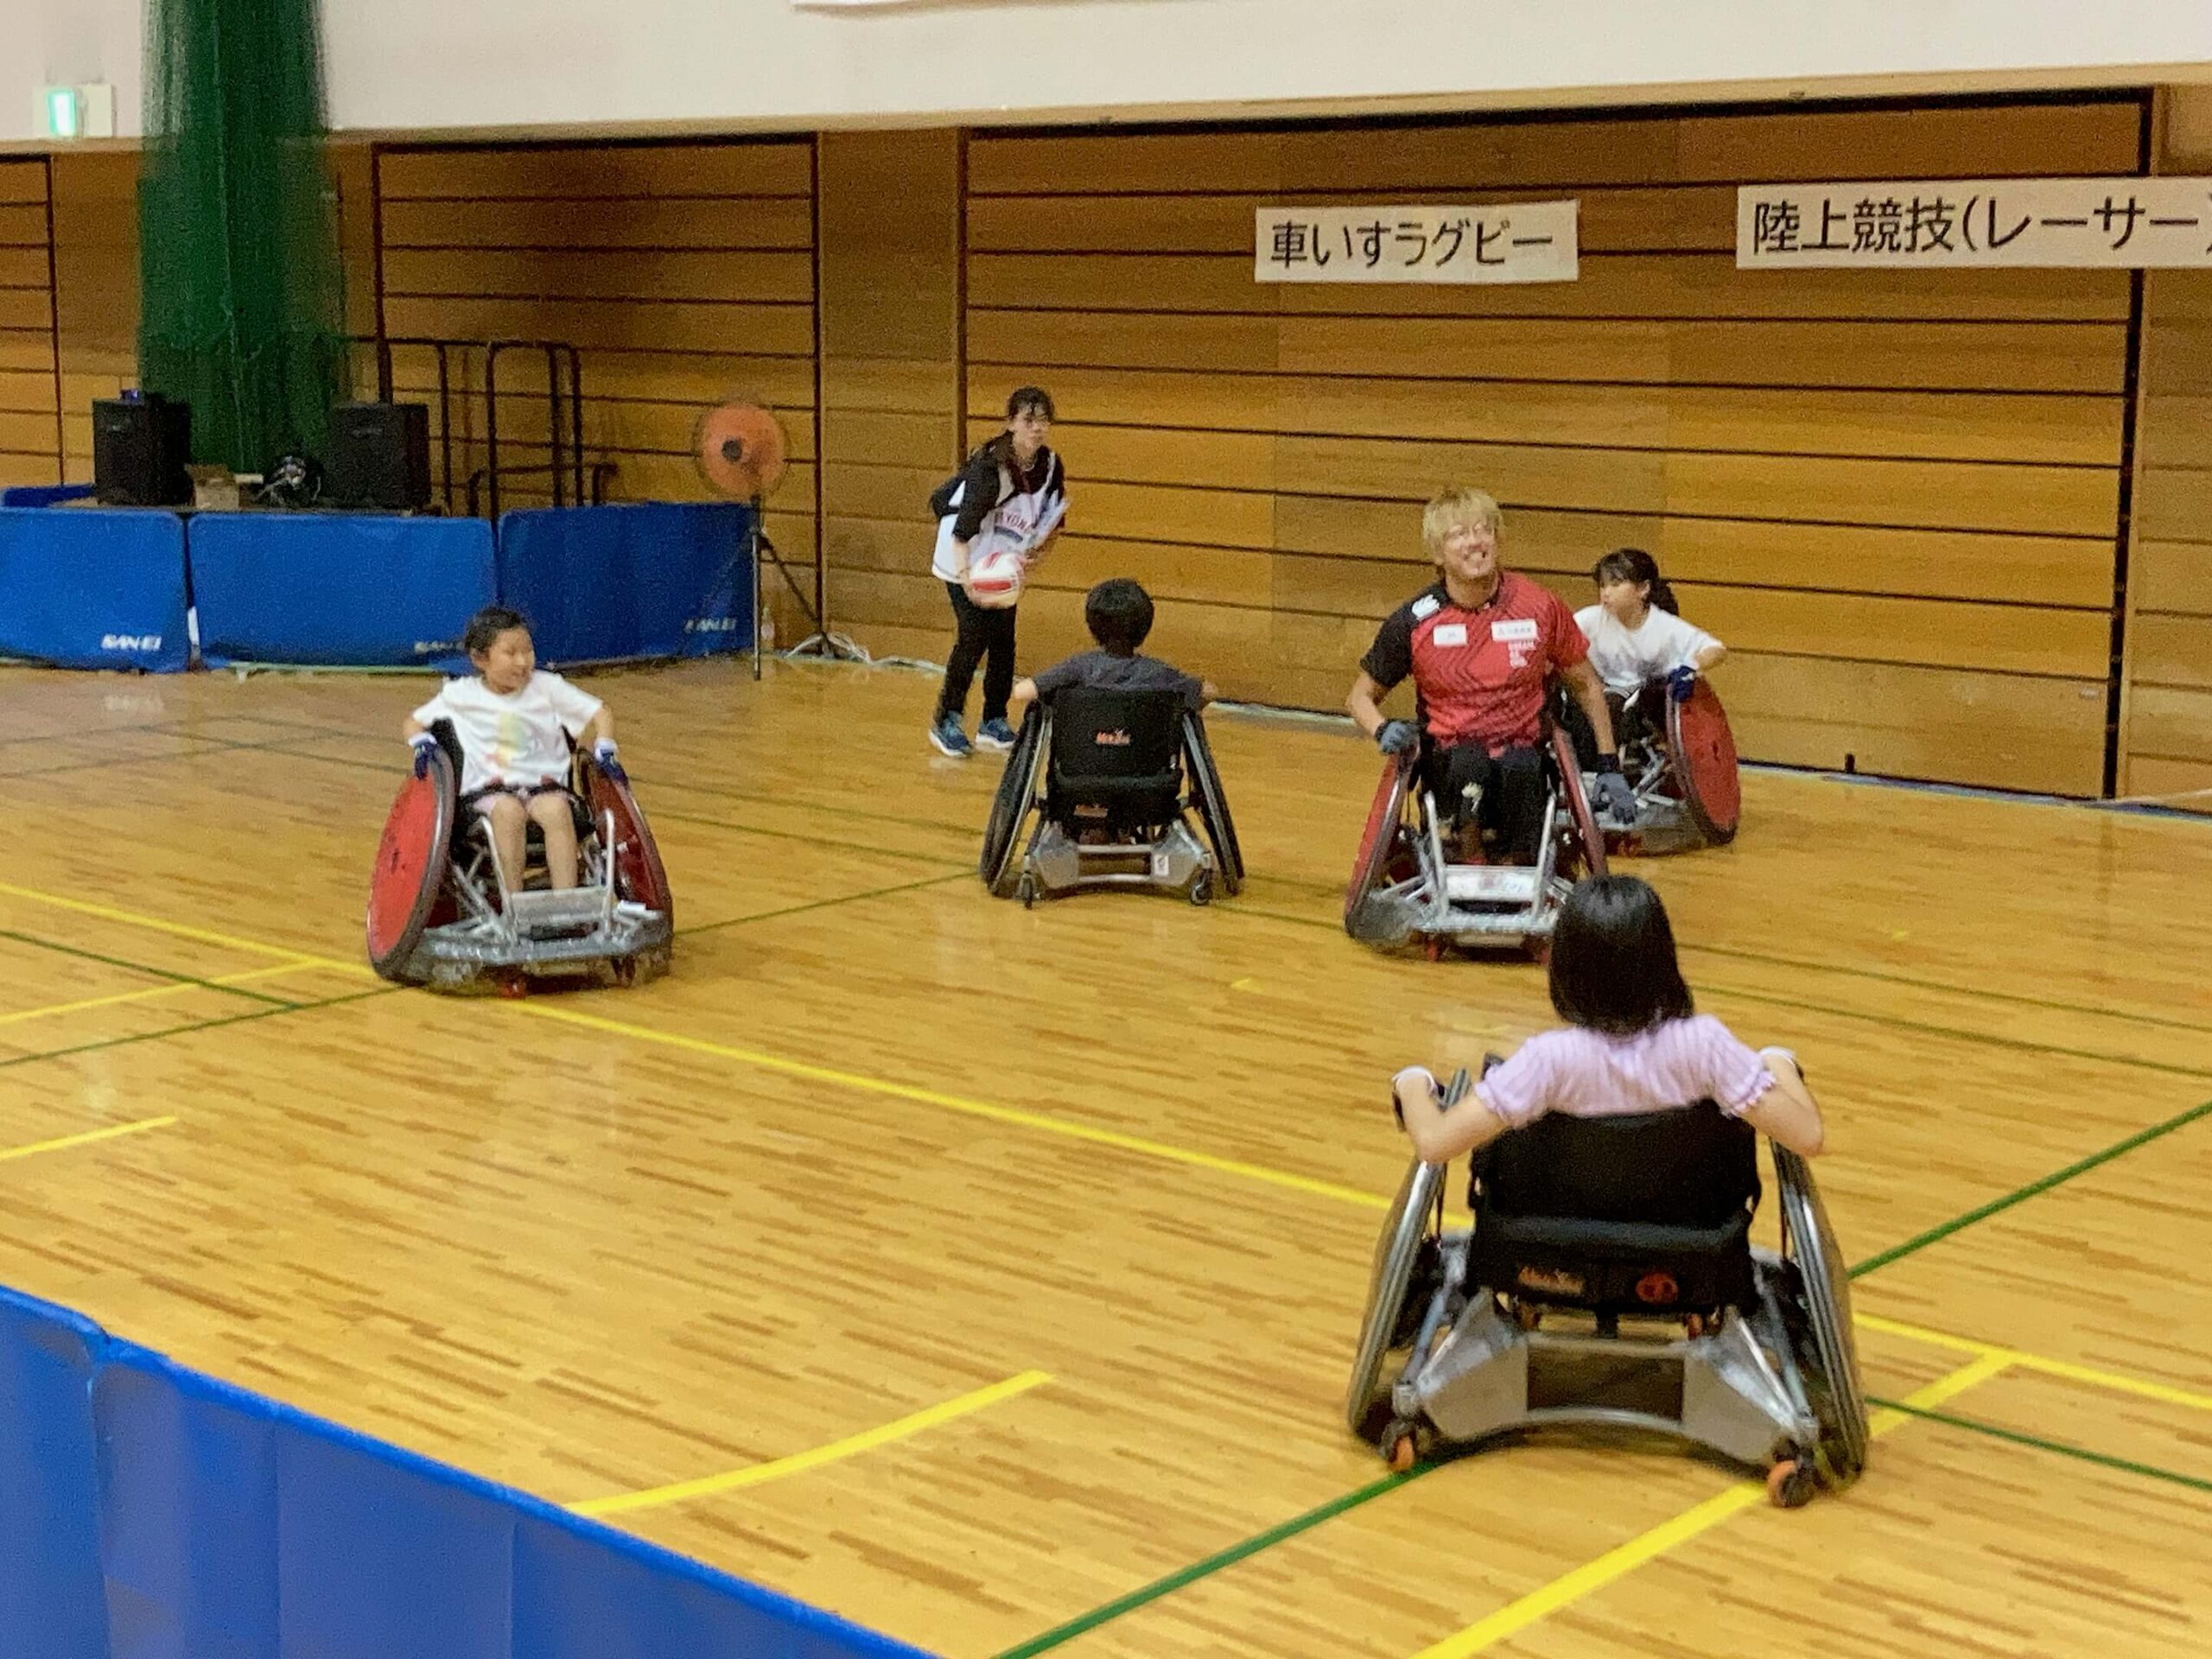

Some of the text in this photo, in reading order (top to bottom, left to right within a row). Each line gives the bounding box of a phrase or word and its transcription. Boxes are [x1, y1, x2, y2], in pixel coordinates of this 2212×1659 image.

[1270, 218, 1553, 269] 車いすラグビー
